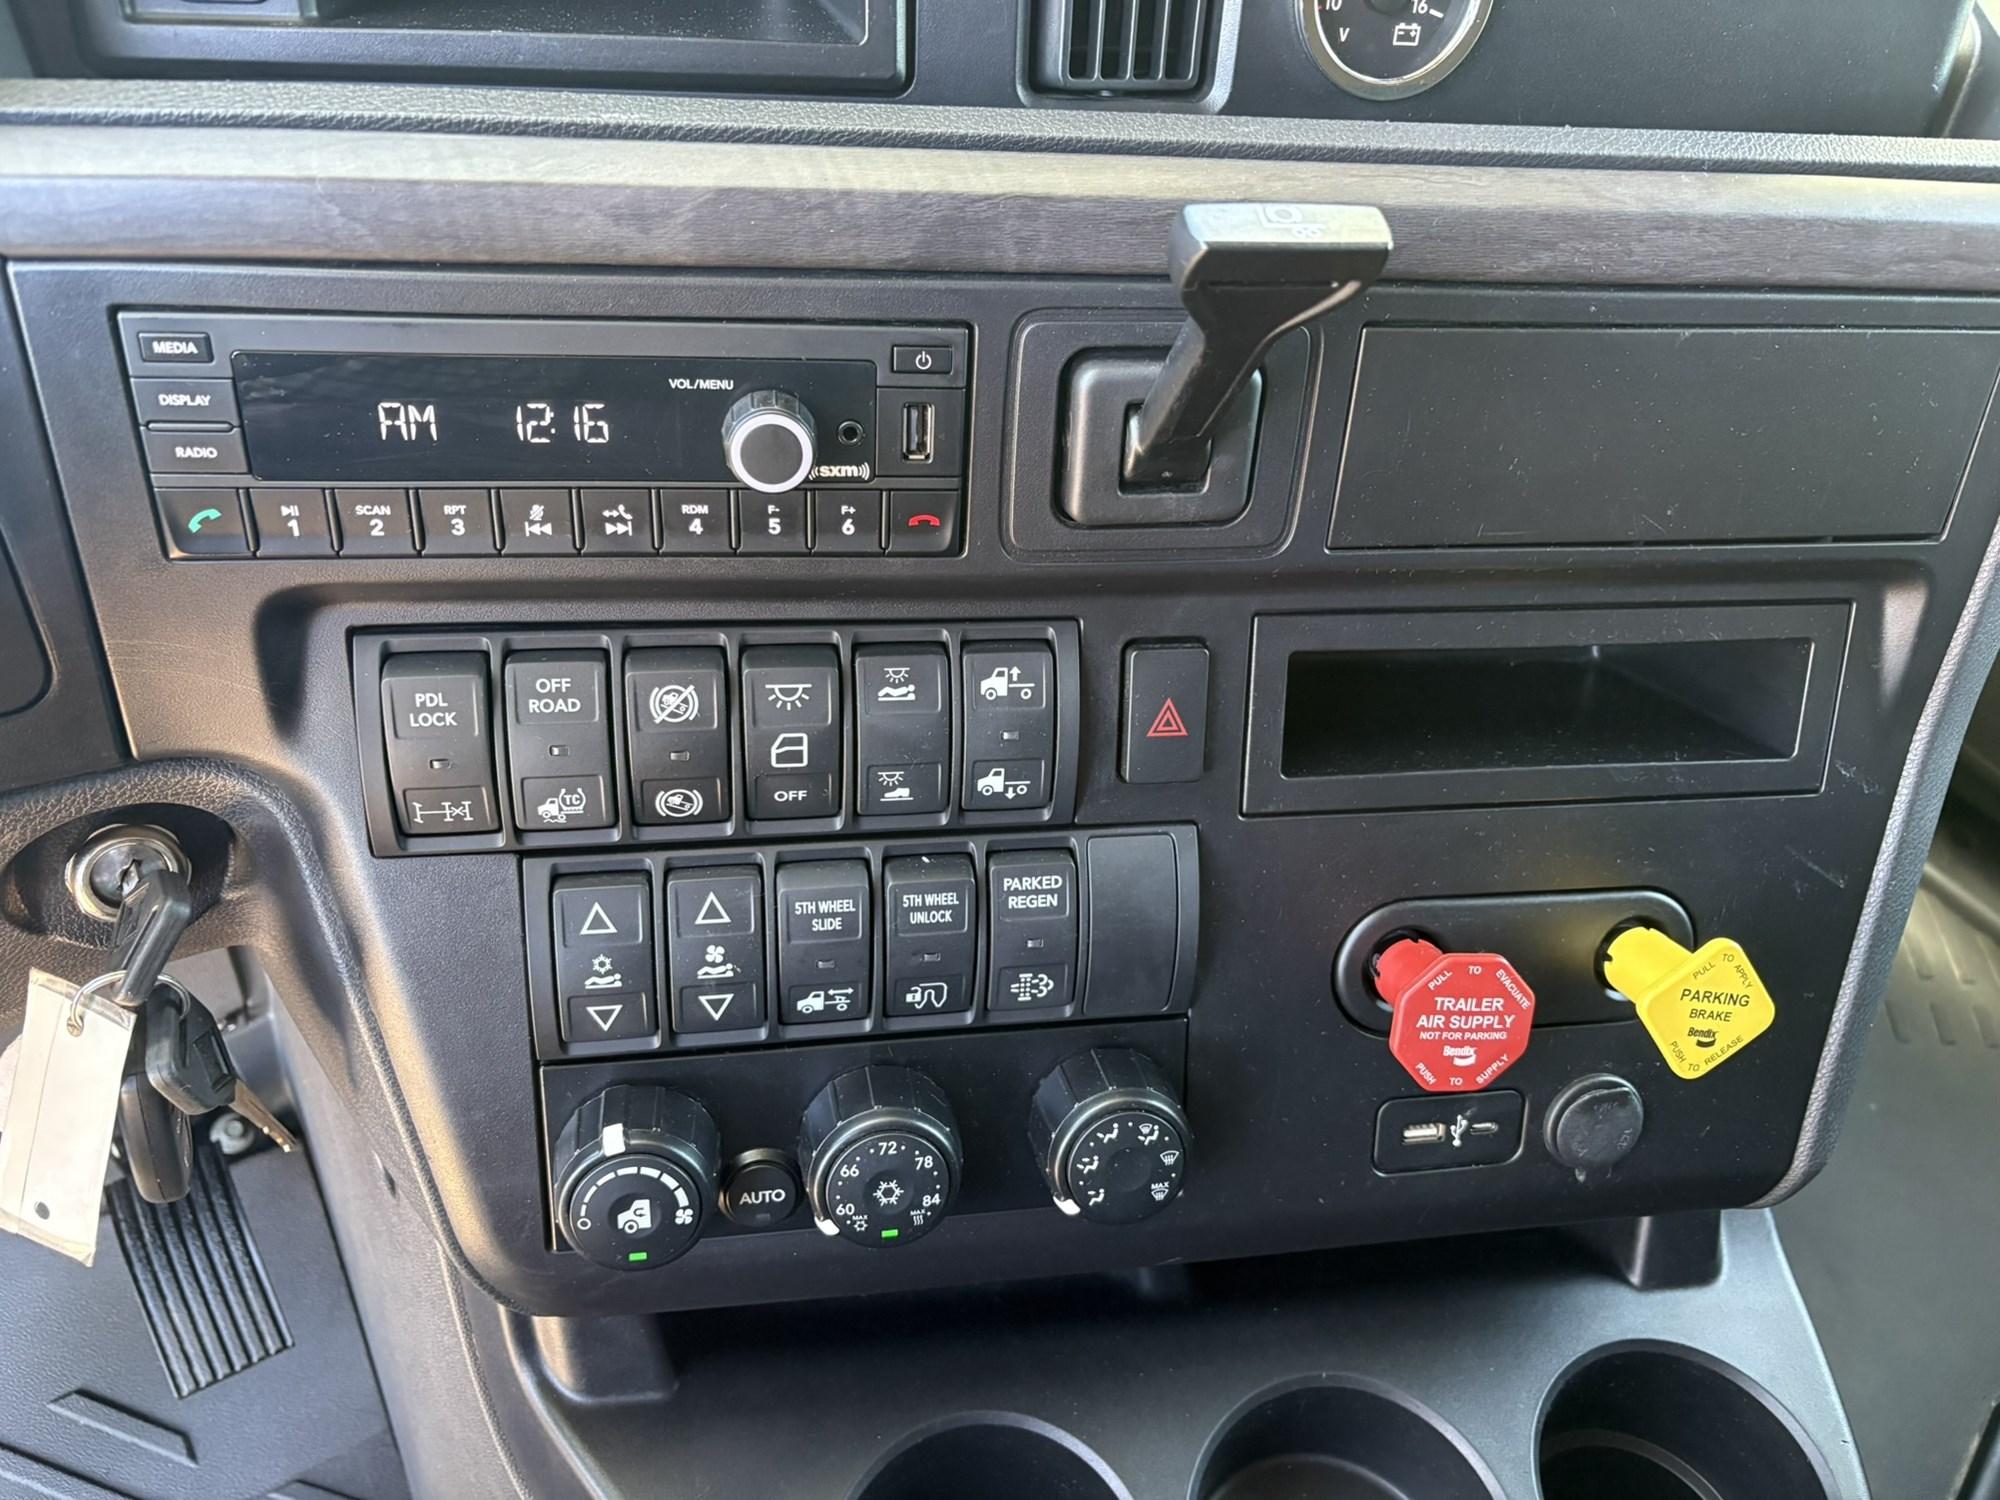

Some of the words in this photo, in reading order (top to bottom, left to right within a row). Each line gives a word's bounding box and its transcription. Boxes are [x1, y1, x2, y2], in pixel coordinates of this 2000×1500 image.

[1339, 27, 1350, 42] V
[152, 340, 198, 355] MEDIA
[668, 378, 734, 391] VOL/MENU
[158, 394, 211, 407] DISPLAY
[377, 402, 438, 442] AM
[515, 402, 610, 444] 12:16
[175, 446, 218, 459] RADIO
[355, 505, 391, 516] SCAN
[444, 505, 466, 516] RPT
[681, 504, 708, 515] RDM
[767, 505, 780, 514] F-
[841, 505, 856, 515] F+
[287, 519, 300, 537] 1
[370, 519, 385, 537] 2
[451, 518, 465, 536] 3
[688, 520, 703, 536] 4
[768, 520, 781, 536] 5
[841, 519, 856, 535] 6
[535, 678, 571, 694] OFF
[415, 693, 449, 708] PDL
[528, 698, 581, 713] ROAD
[409, 711, 457, 727] LOCK
[774, 789, 807, 802] OFF
[1003, 875, 1063, 891] PARKED
[794, 901, 816, 915] 5TH
[818, 899, 856, 913] WHEEL
[902, 894, 922, 908] 5TH
[924, 892, 959, 907] WHEEL
[1008, 894, 1058, 909] REGEN
[812, 917, 843, 931] SLIDE
[909, 910, 953, 925] UNLOCK
[1692, 961, 1716, 980] PULL
[1722, 953, 1735, 963] TO
[1734, 964, 1753, 989] APPLY
[1428, 969, 1453, 990] PULL
[1468, 965, 1482, 975] TO
[1495, 968, 1531, 1010] EVACUATE
[1434, 997, 1504, 1012] TRAILER
[1680, 988, 1750, 1007] PARKING
[1416, 1014, 1445, 1028] AIR
[1449, 1014, 1516, 1029] SUPPLY
[1689, 1008, 1733, 1022] BRAKE
[1419, 1031, 1440, 1040] NOT
[1442, 1031, 1462, 1040] FOR
[1464, 1031, 1508, 1040] PARKING
[1688, 1026, 1719, 1039] Bendix
[1443, 1045, 1477, 1057] Bendix
[1670, 1040, 1688, 1063] PUSH
[1687, 1063, 1700, 1072] TO
[1704, 1034, 1744, 1066] RELEASE
[1416, 1062, 1437, 1085] PUSH
[1449, 1077, 1463, 1086] TO
[1476, 1053, 1509, 1084] SUPPLY
[878, 1141, 898, 1155] 72
[915, 1155, 934, 1170] 78
[840, 1164, 860, 1178] 66
[1151, 1181, 1170, 1190] MAX
[739, 1188, 786, 1206] AUTO
[922, 1193, 941, 1207] 84
[836, 1203, 855, 1216] 60
[909, 1208, 926, 1216] MAX
